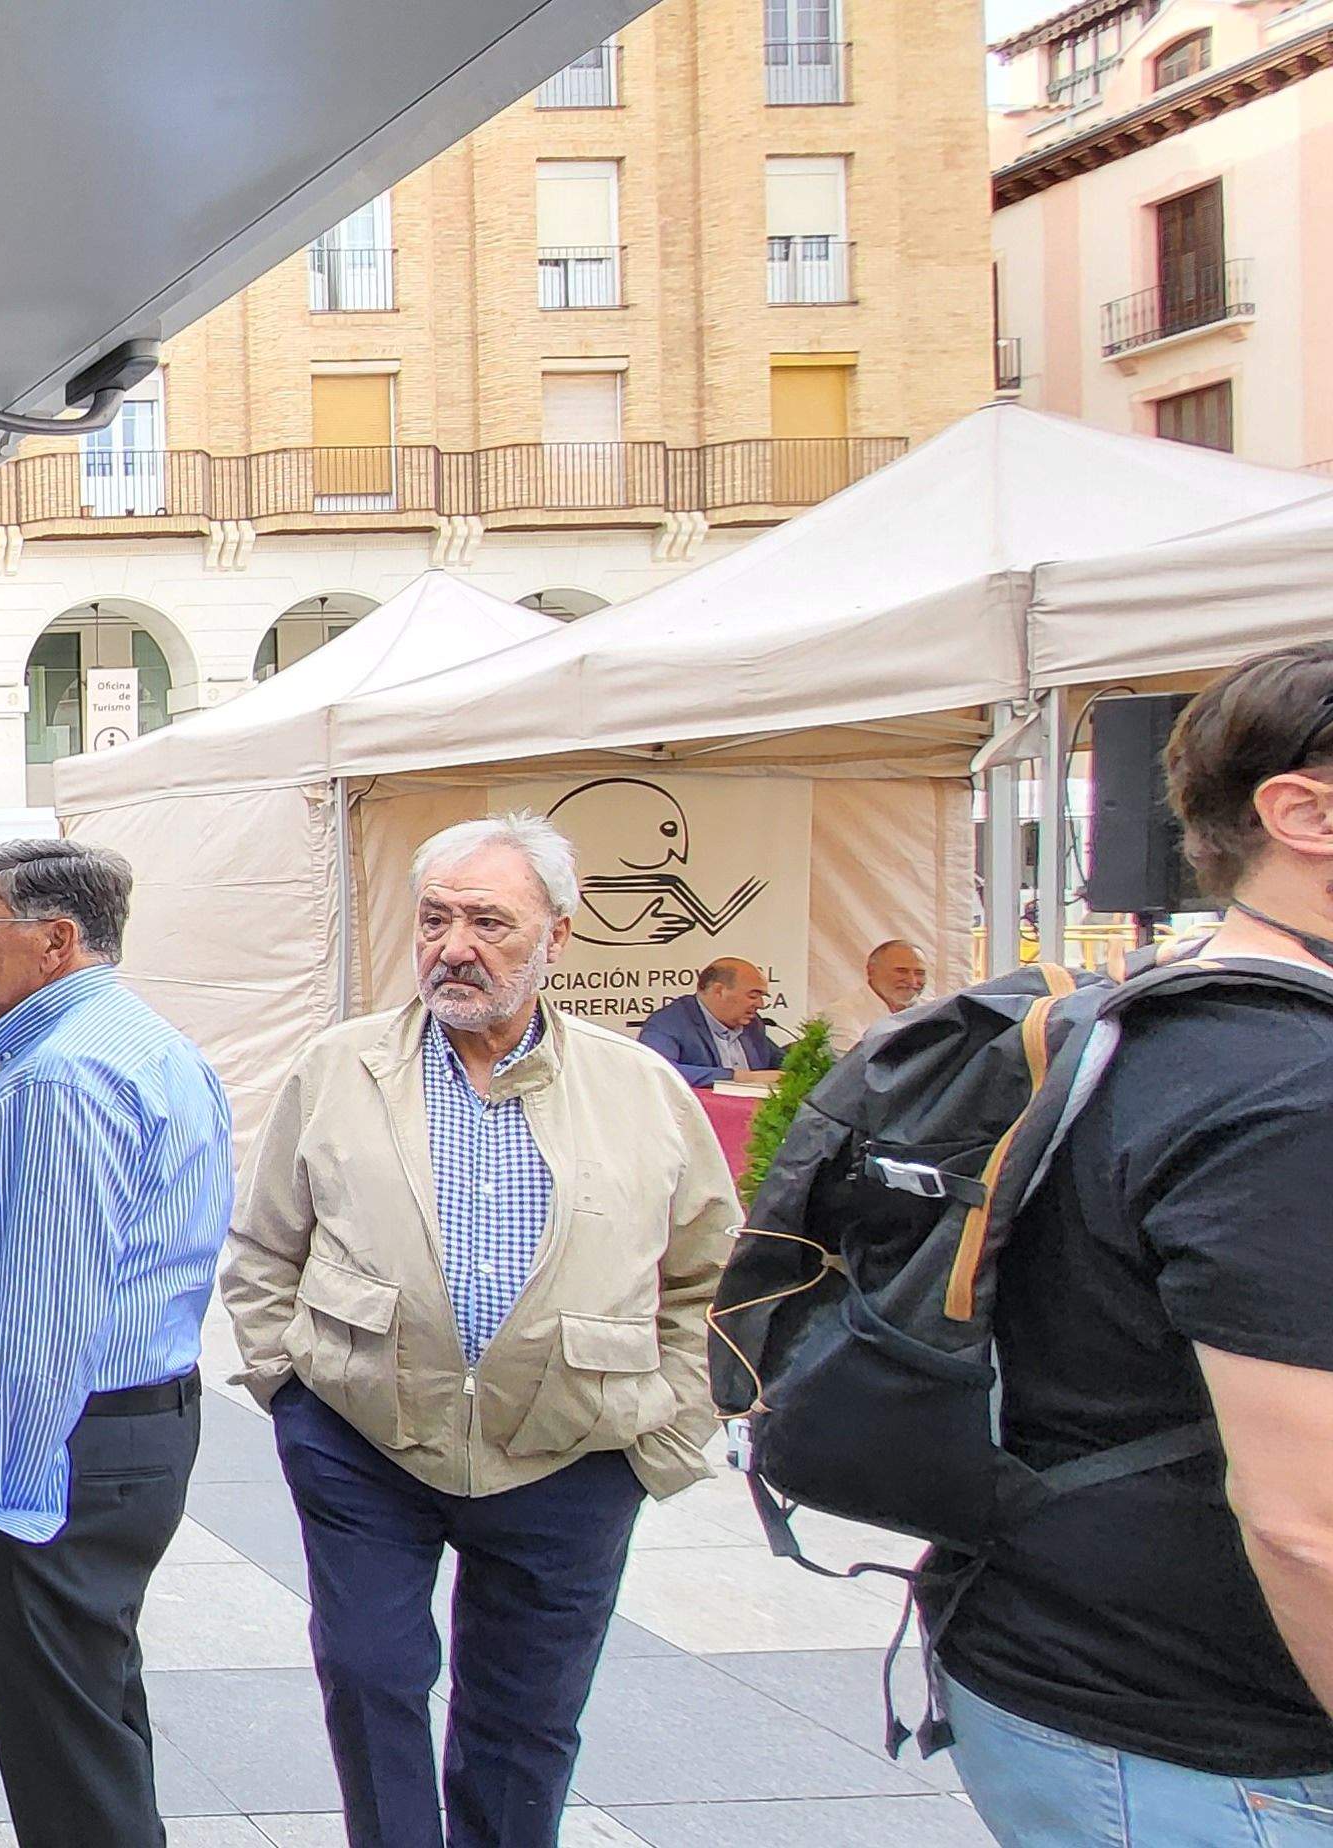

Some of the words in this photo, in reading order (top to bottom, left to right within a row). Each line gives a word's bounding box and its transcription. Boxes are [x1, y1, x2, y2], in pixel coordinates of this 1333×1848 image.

[97, 682, 131, 691] Oficina
[118, 693, 131, 701] de
[93, 703, 131, 712] Turismo
[553, 996, 654, 1018] IBRERIAS
